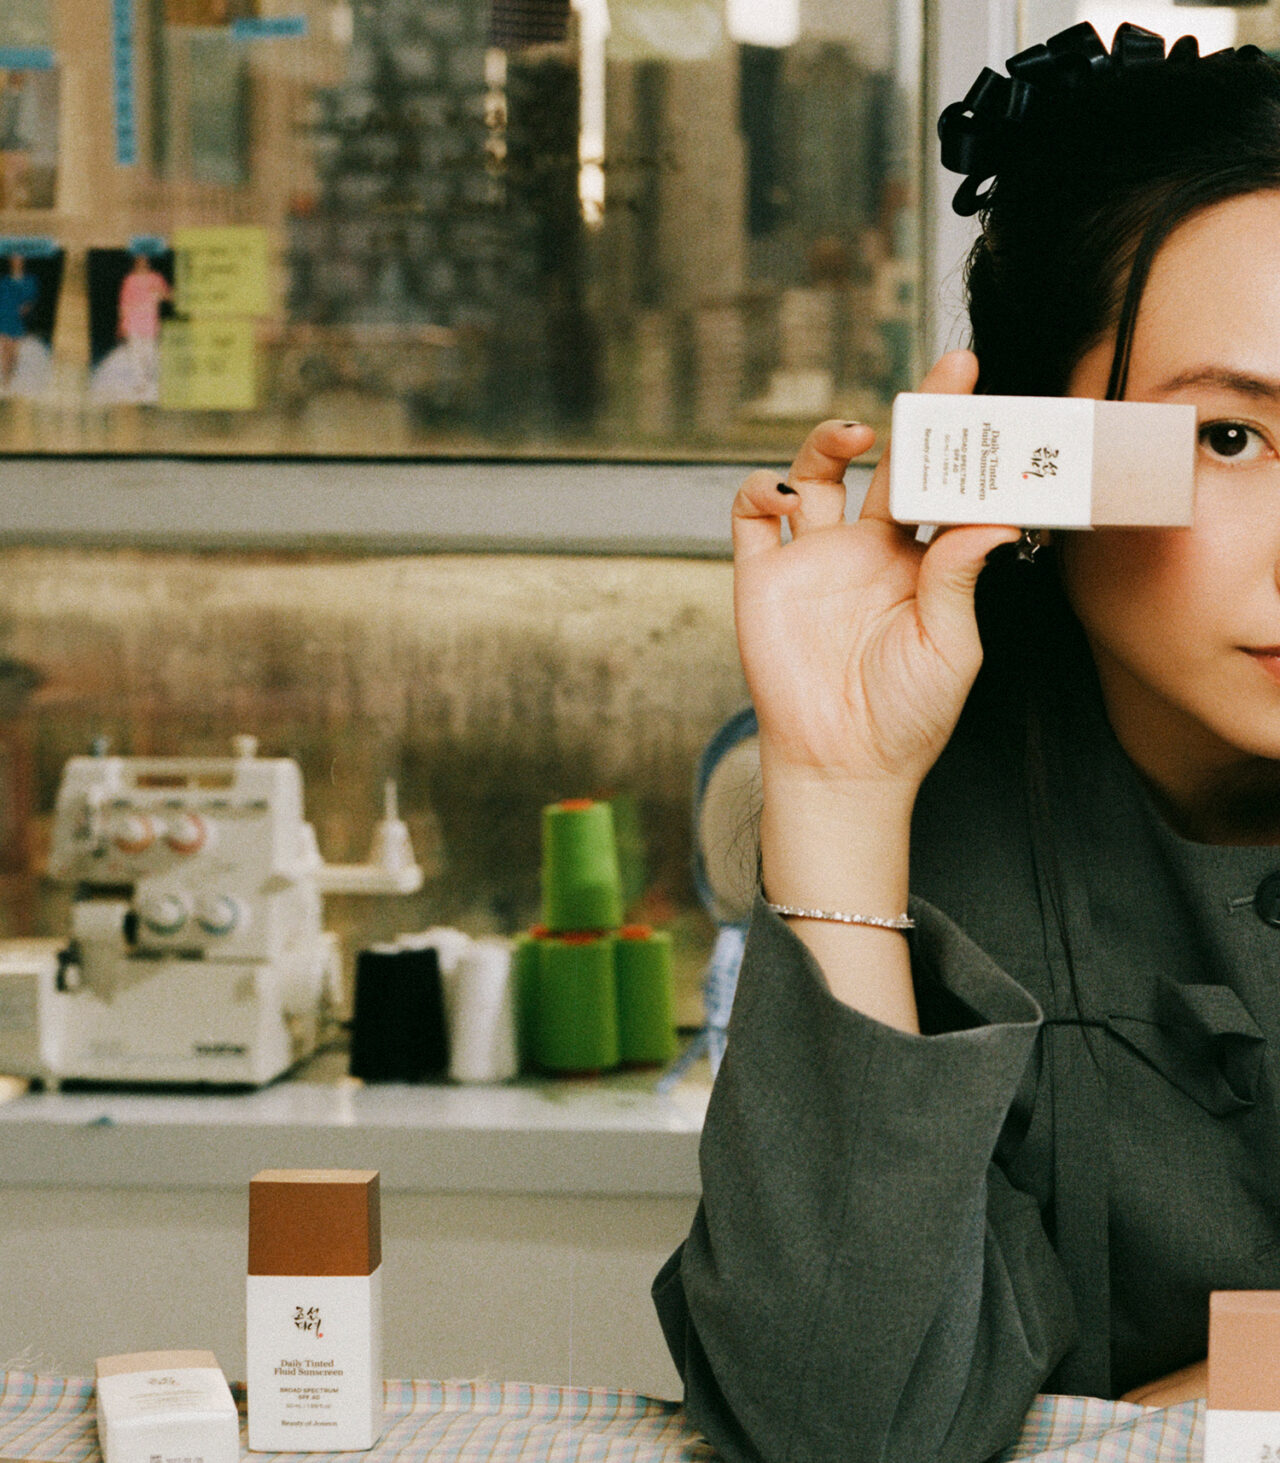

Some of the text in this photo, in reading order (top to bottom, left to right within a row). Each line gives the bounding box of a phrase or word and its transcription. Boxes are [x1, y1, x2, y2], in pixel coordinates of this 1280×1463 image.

[979, 422, 991, 501] Fluid Sunscreen
[988, 430, 1000, 490] Daily Tinted
[274, 1367, 344, 1376] Fluid Sunscreen
[280, 1359, 335, 1368] Daily Tinted
